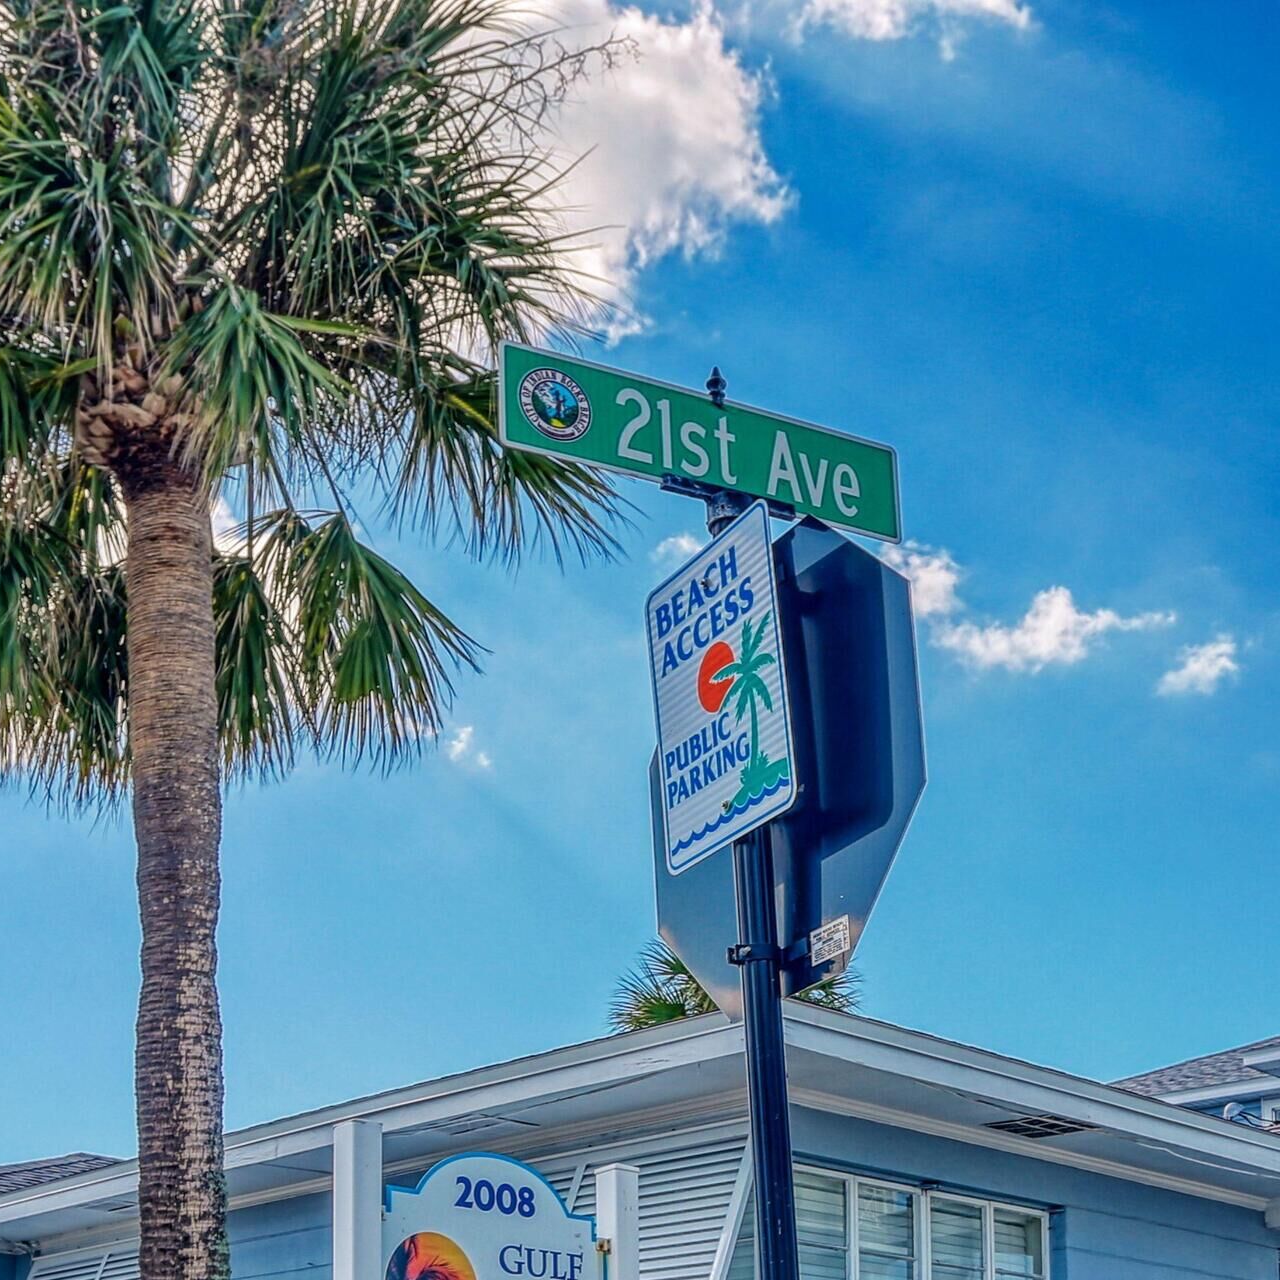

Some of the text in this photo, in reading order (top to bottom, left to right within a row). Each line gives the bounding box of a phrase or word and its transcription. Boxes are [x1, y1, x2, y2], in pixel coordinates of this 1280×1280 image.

[615, 388, 861, 517] 21st Ave
[655, 545, 738, 640] BEACH
[661, 576, 754, 679] ACCESS
[665, 711, 731, 779] PUBLIC
[667, 732, 750, 810] PARKING
[454, 1176, 536, 1218] 2008
